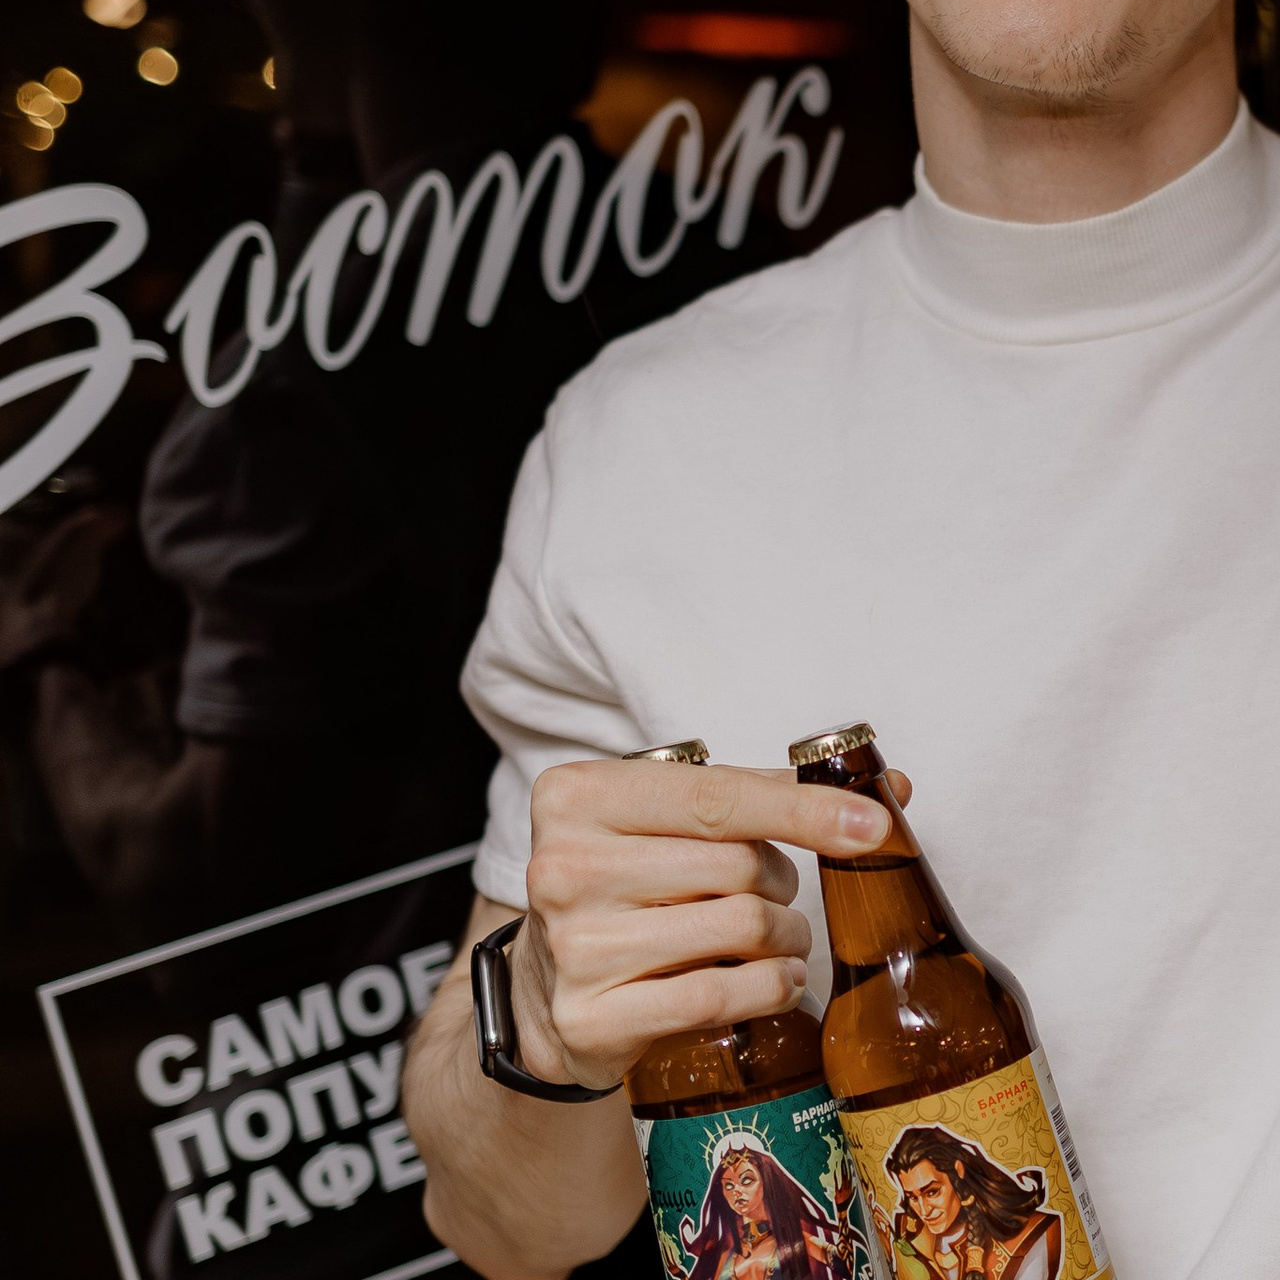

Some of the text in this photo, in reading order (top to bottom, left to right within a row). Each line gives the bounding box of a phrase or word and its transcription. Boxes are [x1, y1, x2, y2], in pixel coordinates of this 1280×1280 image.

[977, 1080, 1028, 1110] БАРНАЯ
[981, 1091, 1031, 1119] ВЕРСИЯ
[792, 1099, 836, 1125] БАРНАЯ
[794, 1111, 838, 1133] ВЕРСИЯ
[176, 1119, 428, 1264] КАФЕ
